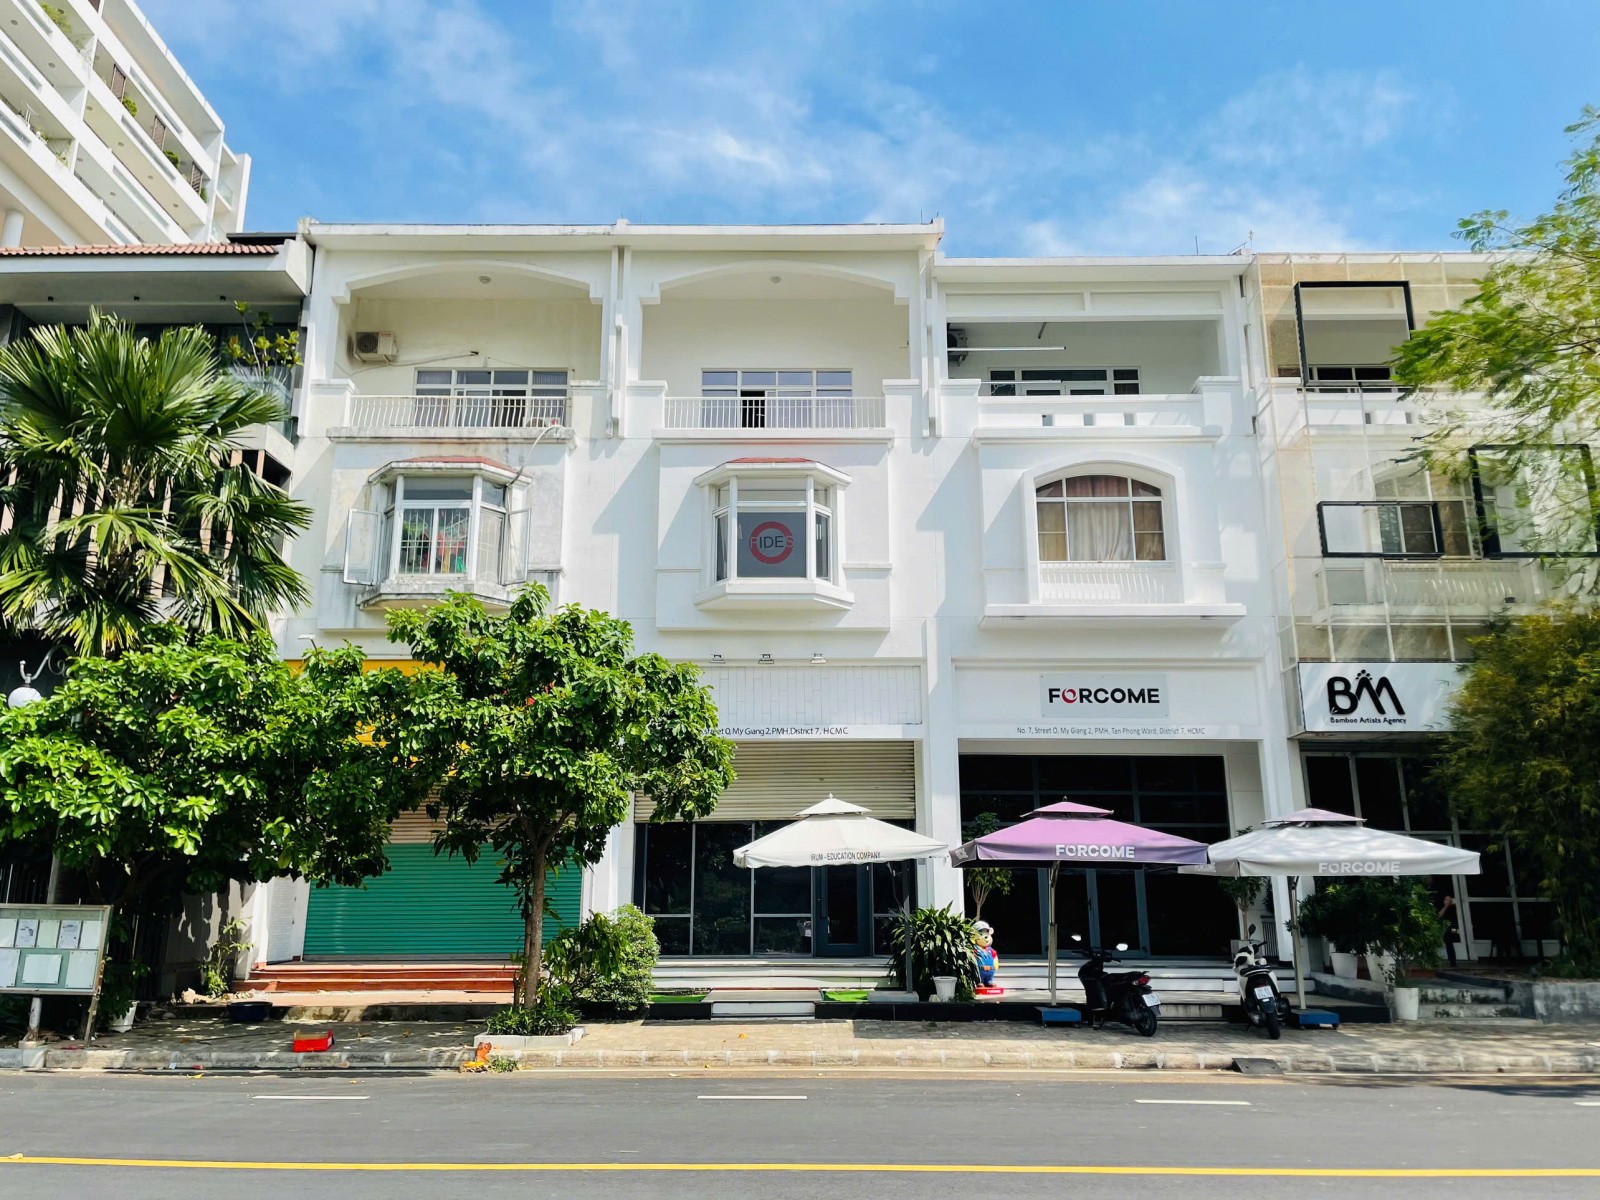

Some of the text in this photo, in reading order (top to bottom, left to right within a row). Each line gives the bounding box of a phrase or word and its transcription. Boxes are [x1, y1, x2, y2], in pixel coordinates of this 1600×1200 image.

[1048, 687, 1160, 704] FORCOME
[1383, 717, 1407, 725] Agency
[732, 727, 744, 736] My
[744, 727, 765, 737] Giang
[823, 727, 849, 736] HCMC
[1060, 727, 1070, 735] My
[1070, 727, 1087, 736] Giang
[1111, 727, 1122, 735] Tan
[1122, 727, 1141, 736] Phong
[1159, 727, 1179, 735] District
[1187, 727, 1206, 735] HCMC
[827, 852, 856, 861] EDUCATION
[856, 851, 881, 861] COMPANY
[1055, 844, 1135, 859] FORCOME
[1318, 861, 1401, 874] FORCOME
